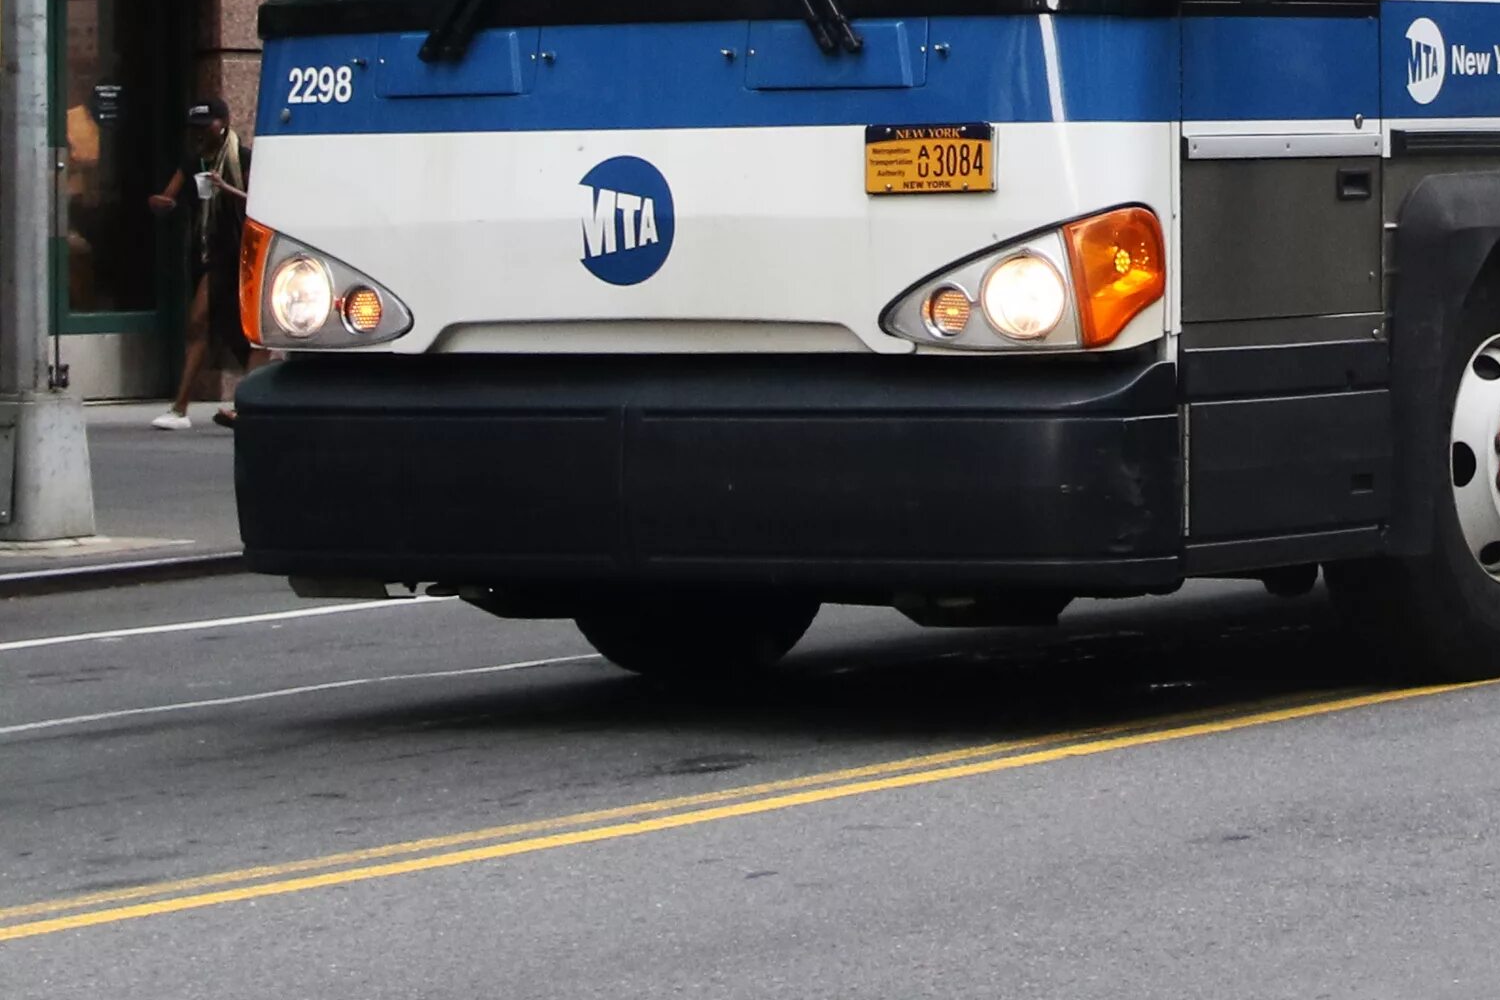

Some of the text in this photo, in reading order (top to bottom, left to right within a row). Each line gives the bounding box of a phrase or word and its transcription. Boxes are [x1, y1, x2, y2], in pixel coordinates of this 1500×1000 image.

[1405, 36, 1441, 87] MTA
[1451, 44, 1490, 76] New
[288, 66, 353, 104] 2298
[896, 127, 961, 140] NEW YORK
[933, 143, 984, 178] 3084
[903, 180, 952, 190] NEW YORK
[577, 183, 660, 261] MTA
